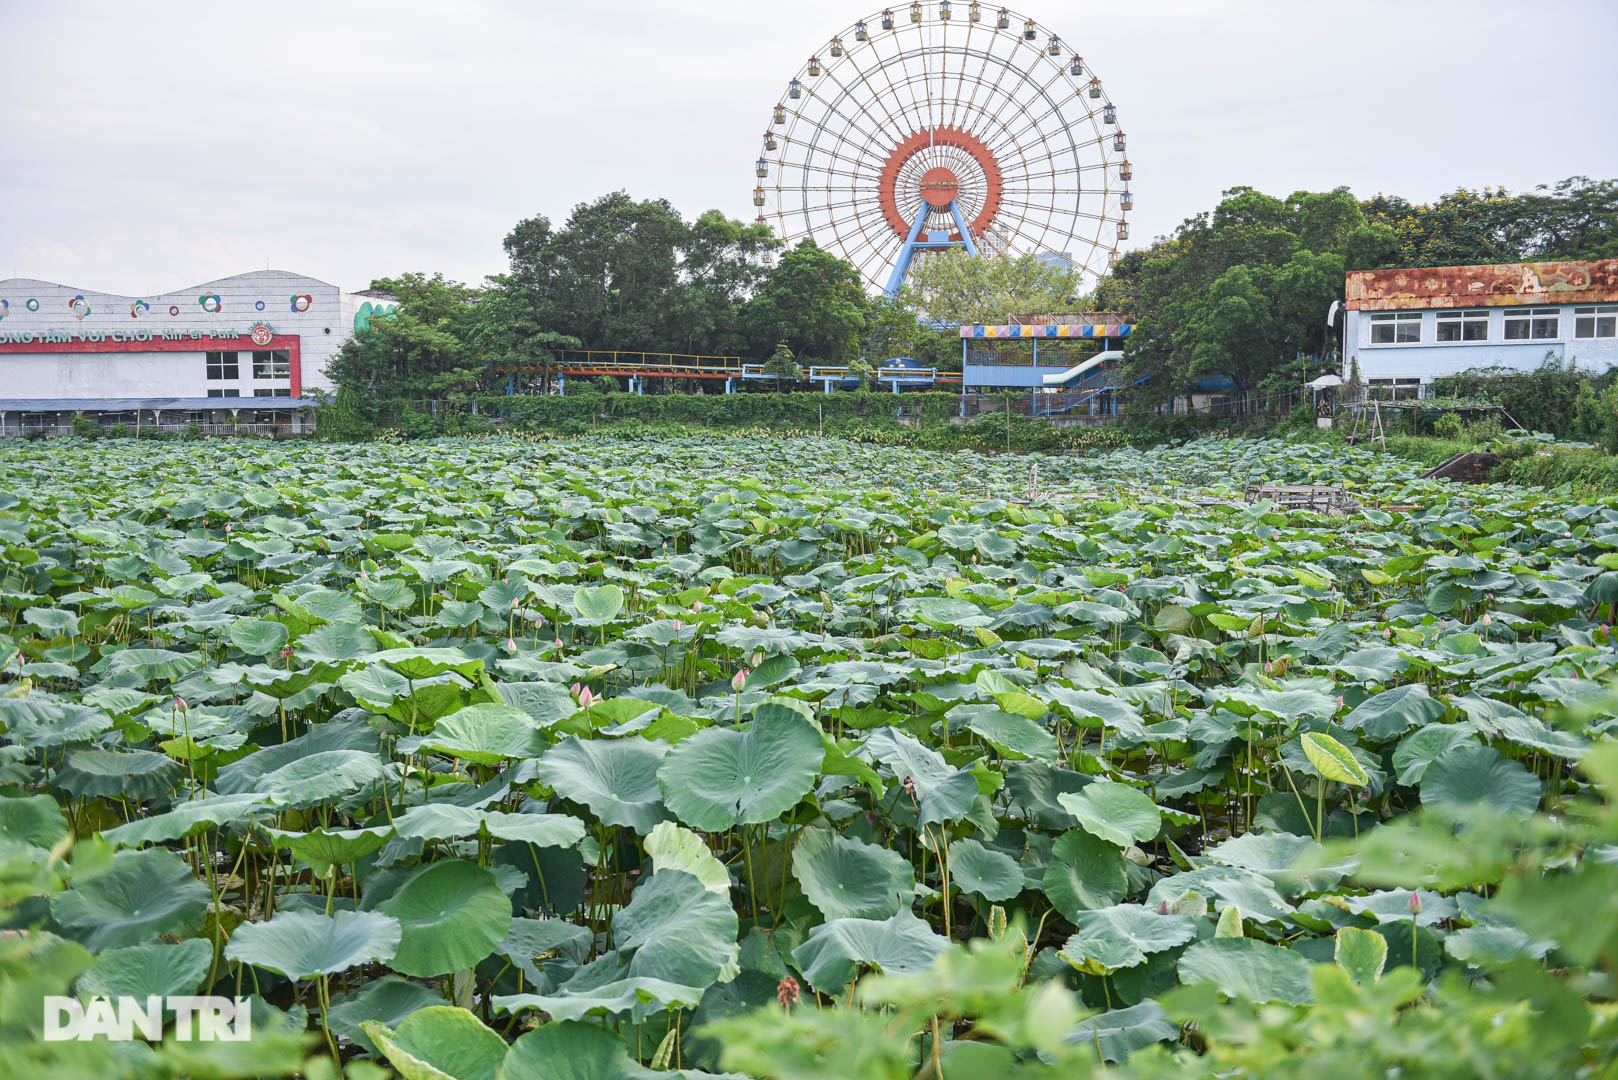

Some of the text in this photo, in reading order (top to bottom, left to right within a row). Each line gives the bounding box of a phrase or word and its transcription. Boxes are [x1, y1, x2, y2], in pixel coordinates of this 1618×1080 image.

[36, 329, 73, 344] TÂM
[77, 330, 106, 343] VUI
[162, 328, 203, 341] Kiner
[209, 328, 240, 340] Park
